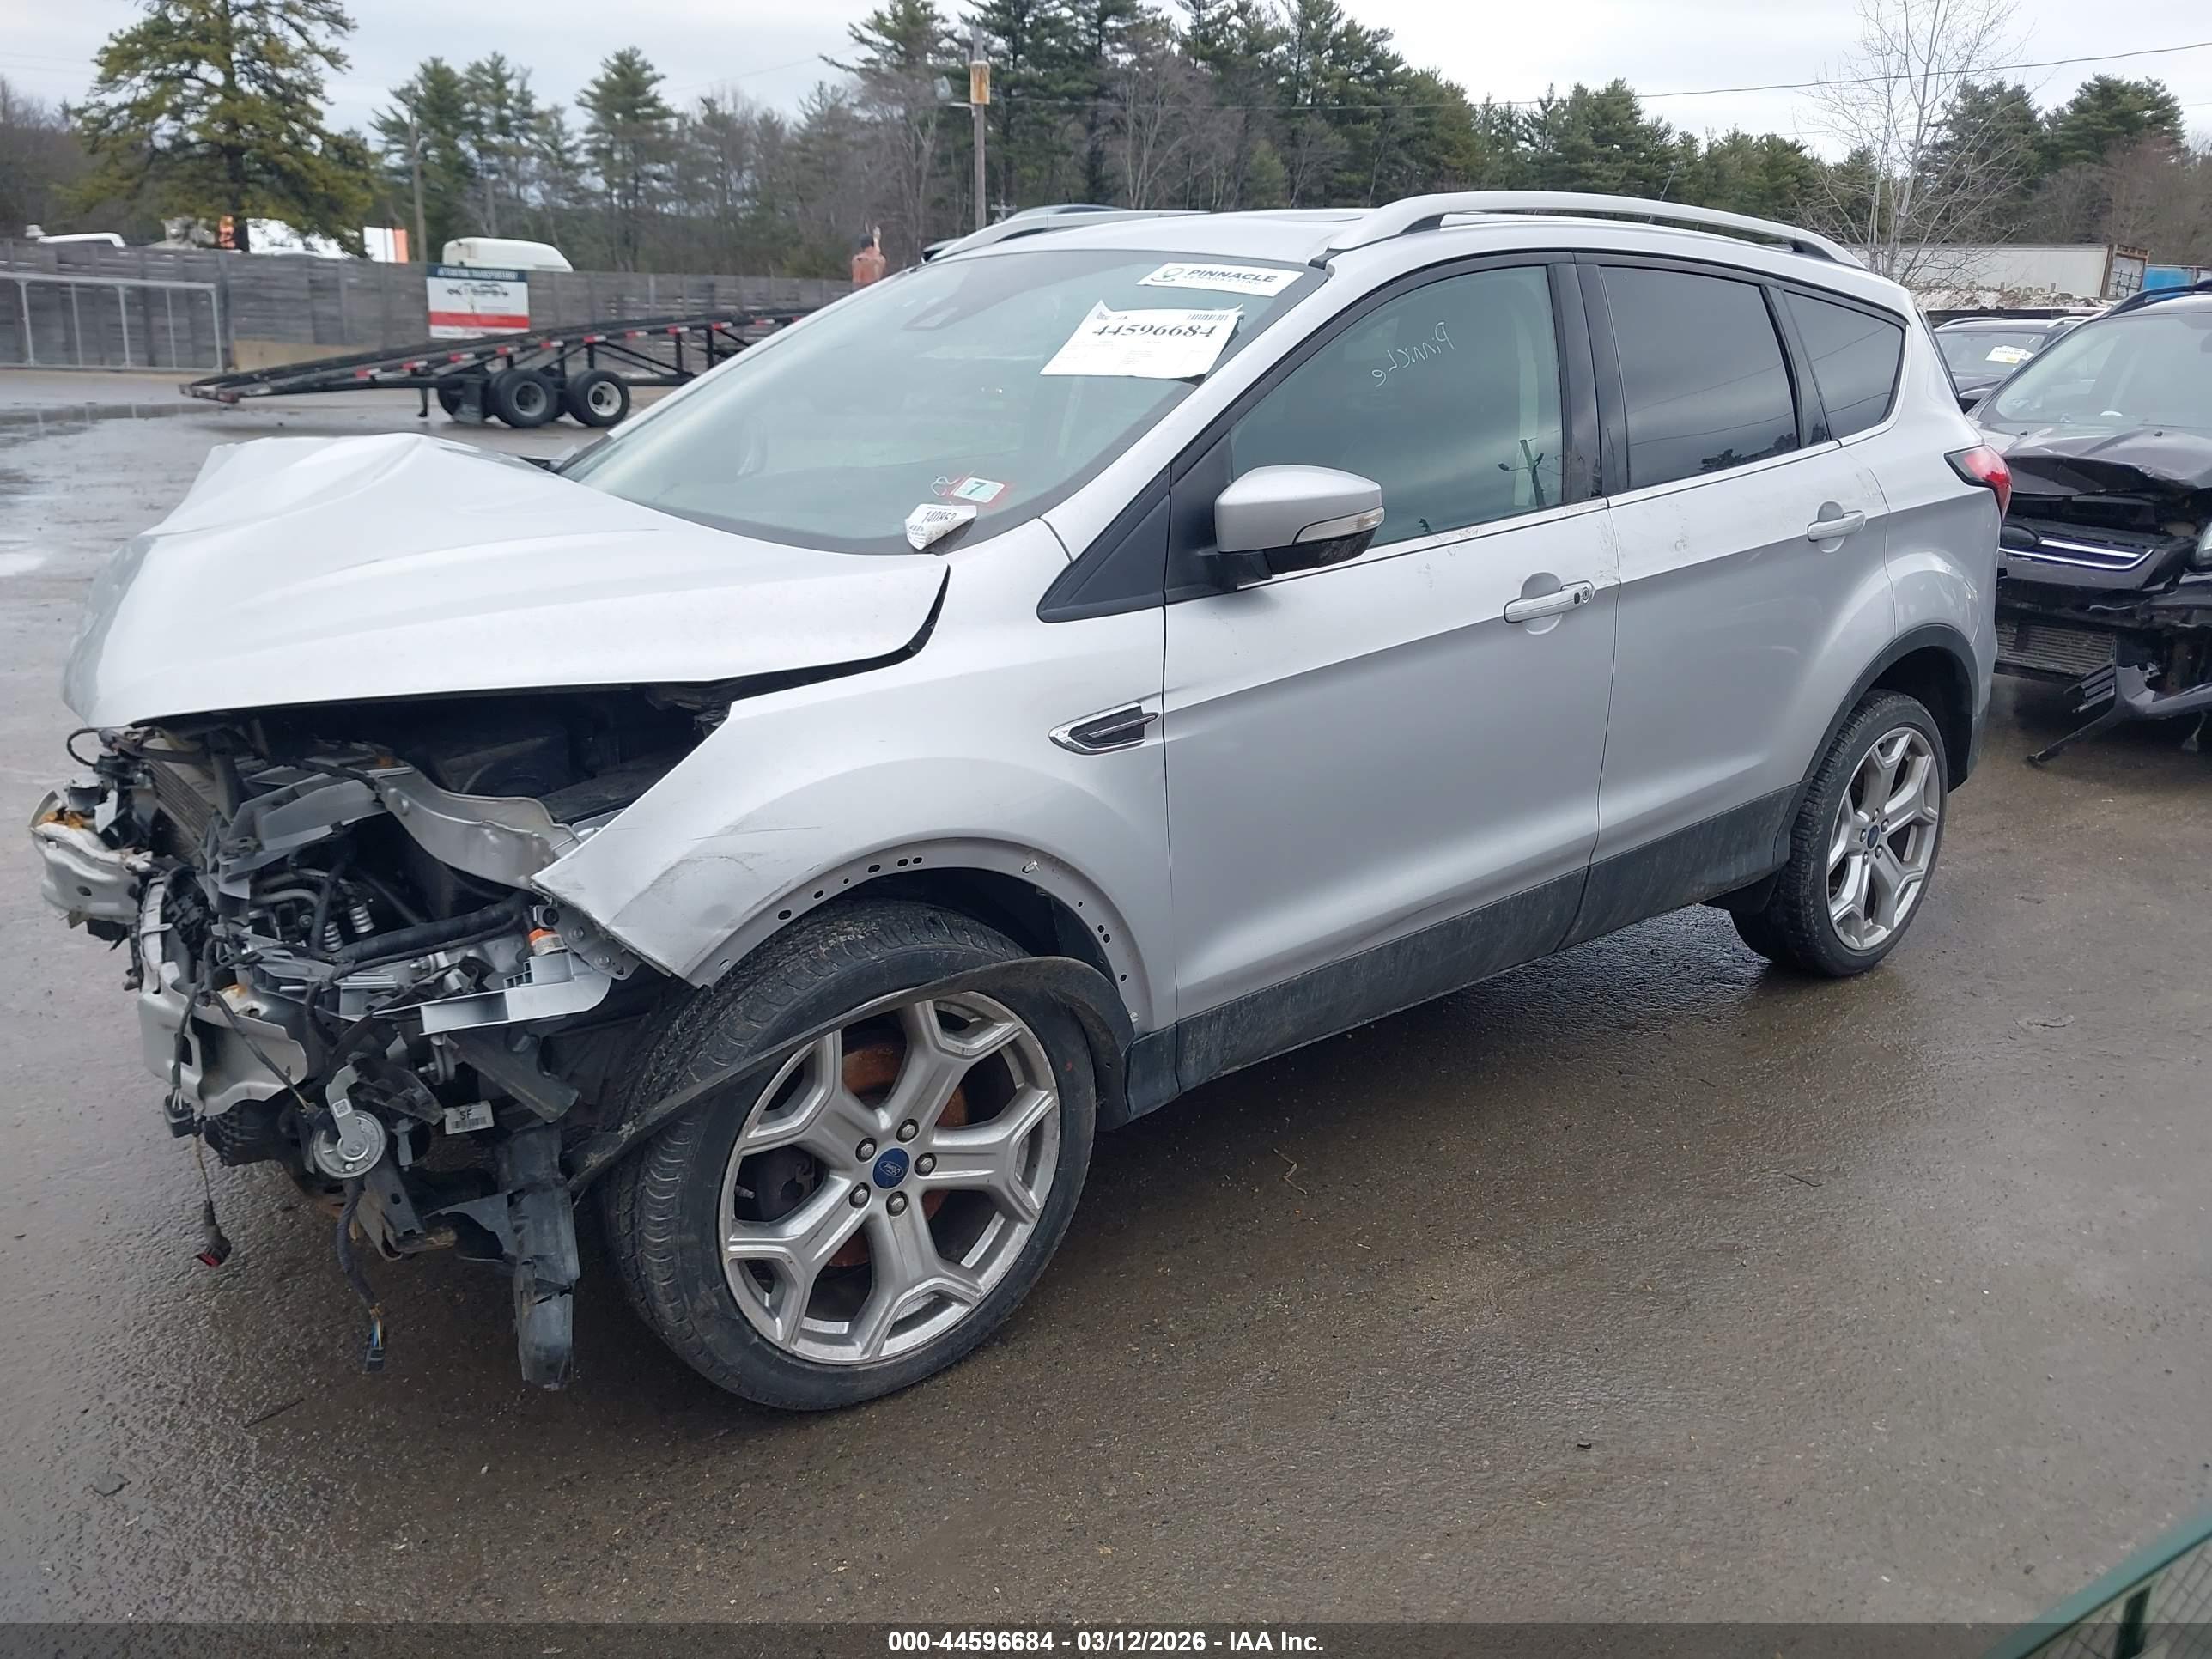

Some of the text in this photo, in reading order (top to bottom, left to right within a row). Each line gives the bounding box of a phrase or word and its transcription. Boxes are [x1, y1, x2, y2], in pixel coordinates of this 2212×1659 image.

[1188, 270, 1279, 282] PINNACLE
[1092, 324, 1218, 337] 44596684
[967, 482, 987, 495] 7
[884, 1163, 901, 1176] Ford
